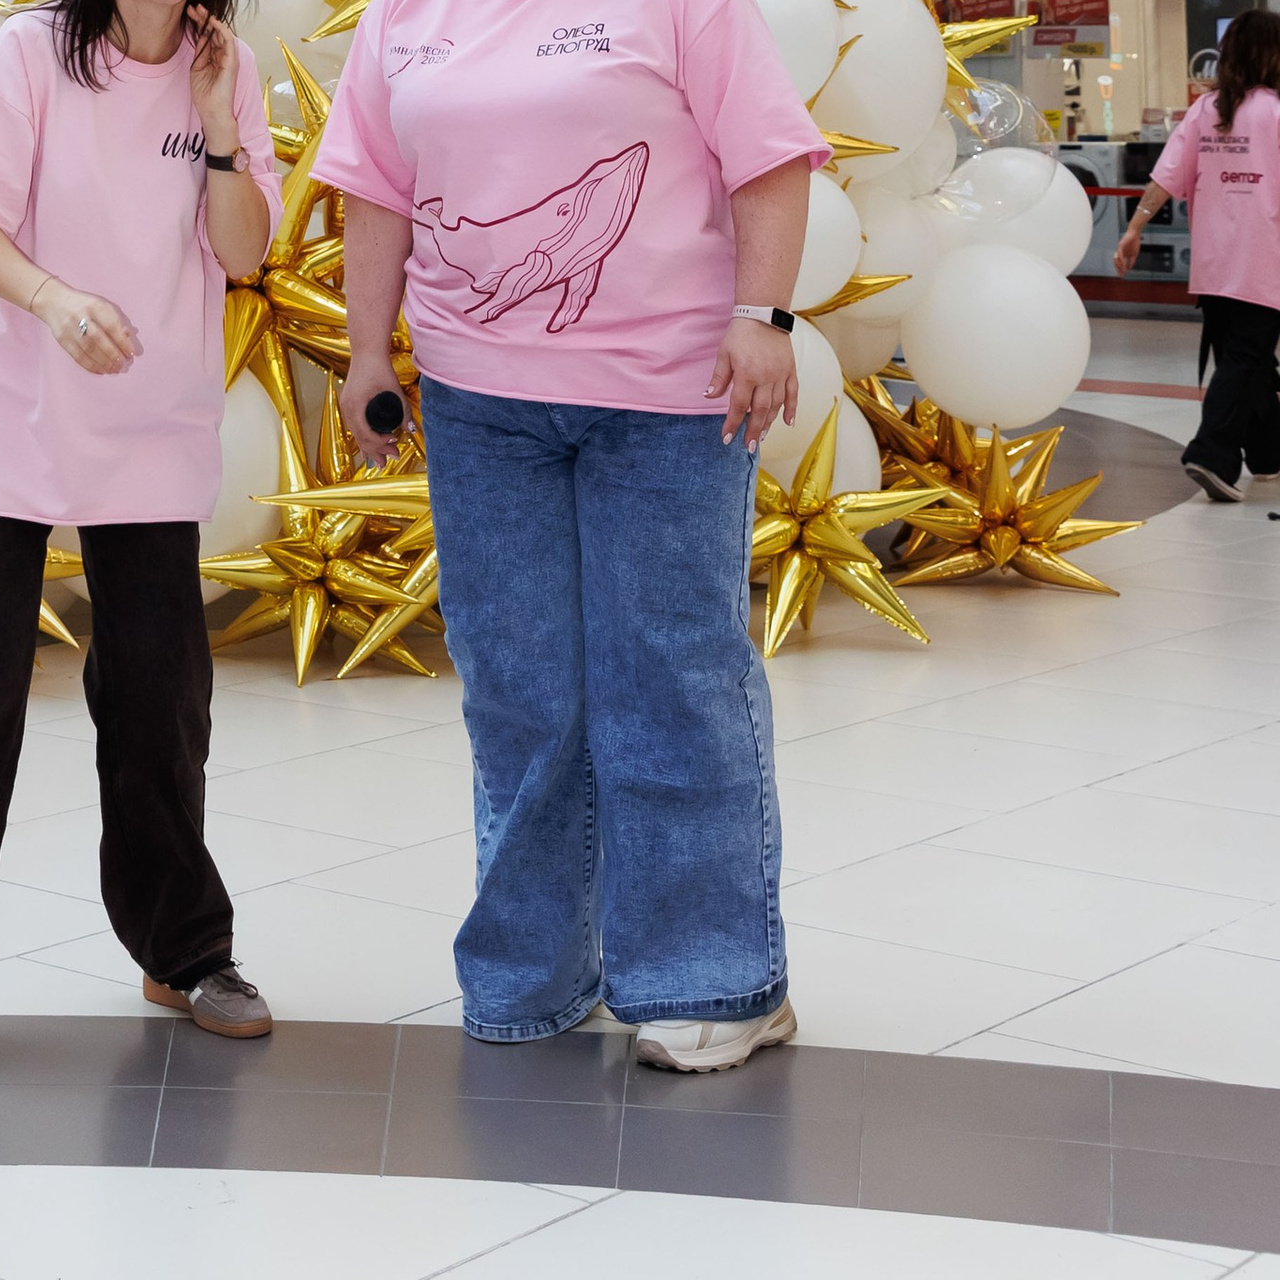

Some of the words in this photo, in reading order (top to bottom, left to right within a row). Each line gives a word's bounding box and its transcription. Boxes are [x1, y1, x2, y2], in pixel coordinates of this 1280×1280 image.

[552, 23, 605, 40] ОЛЕСЯ
[536, 37, 610, 57] БЕЛОГРУД
[420, 55, 449, 65] 2025
